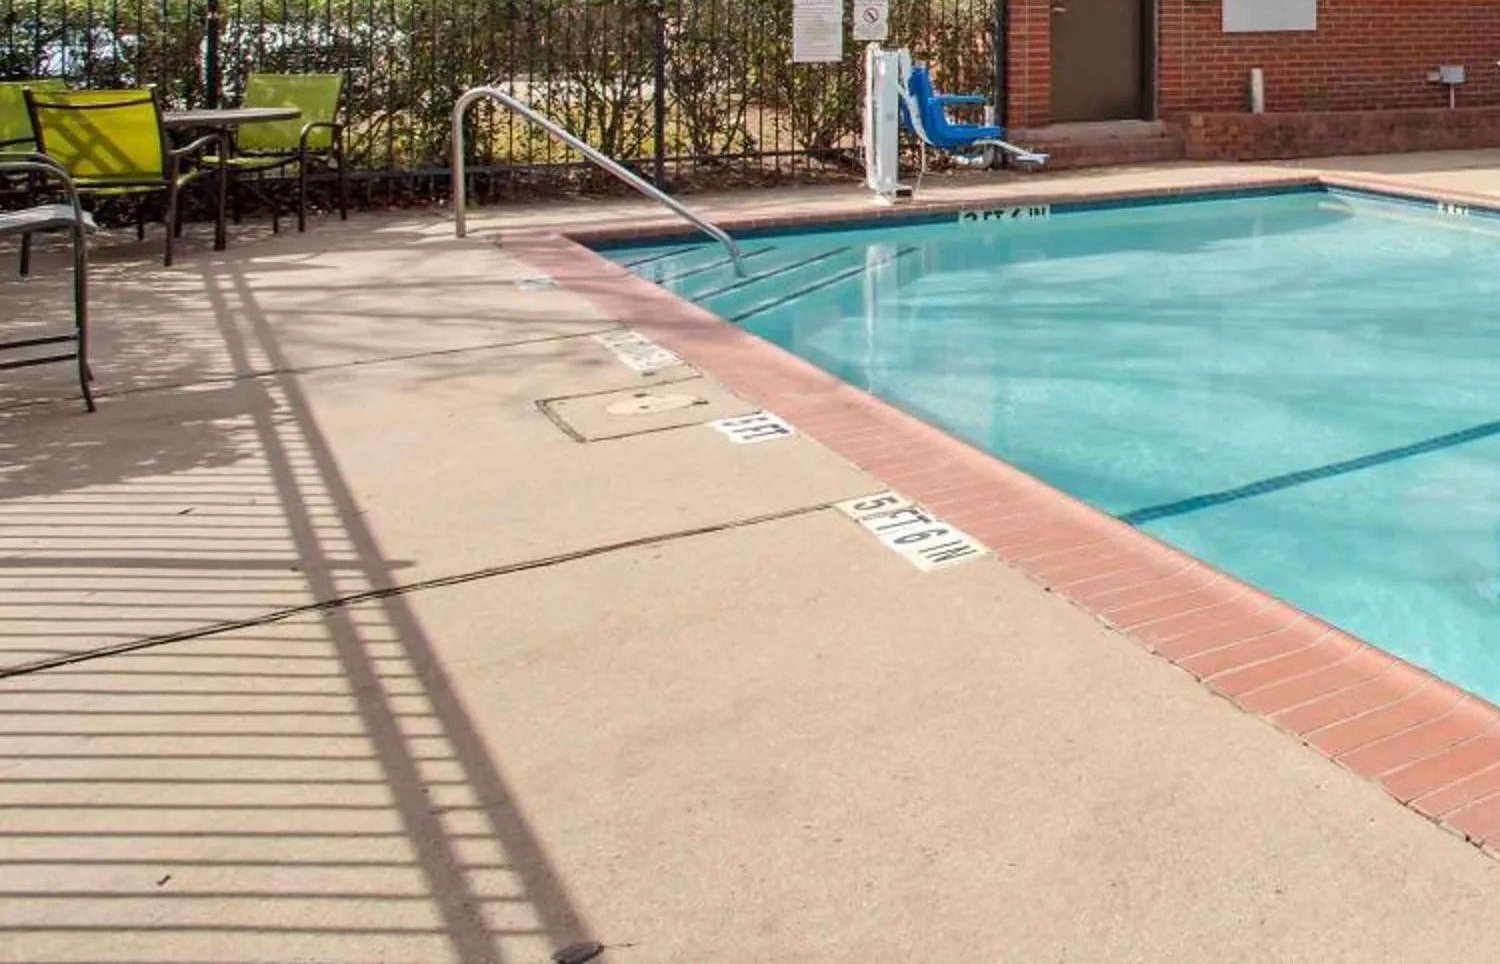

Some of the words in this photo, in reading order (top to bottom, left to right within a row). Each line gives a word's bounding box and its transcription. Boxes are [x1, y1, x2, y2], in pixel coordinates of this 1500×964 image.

[852, 495, 900, 511] 5
[861, 506, 932, 532] FT
[892, 528, 949, 545] 6
[917, 539, 980, 563] IN
